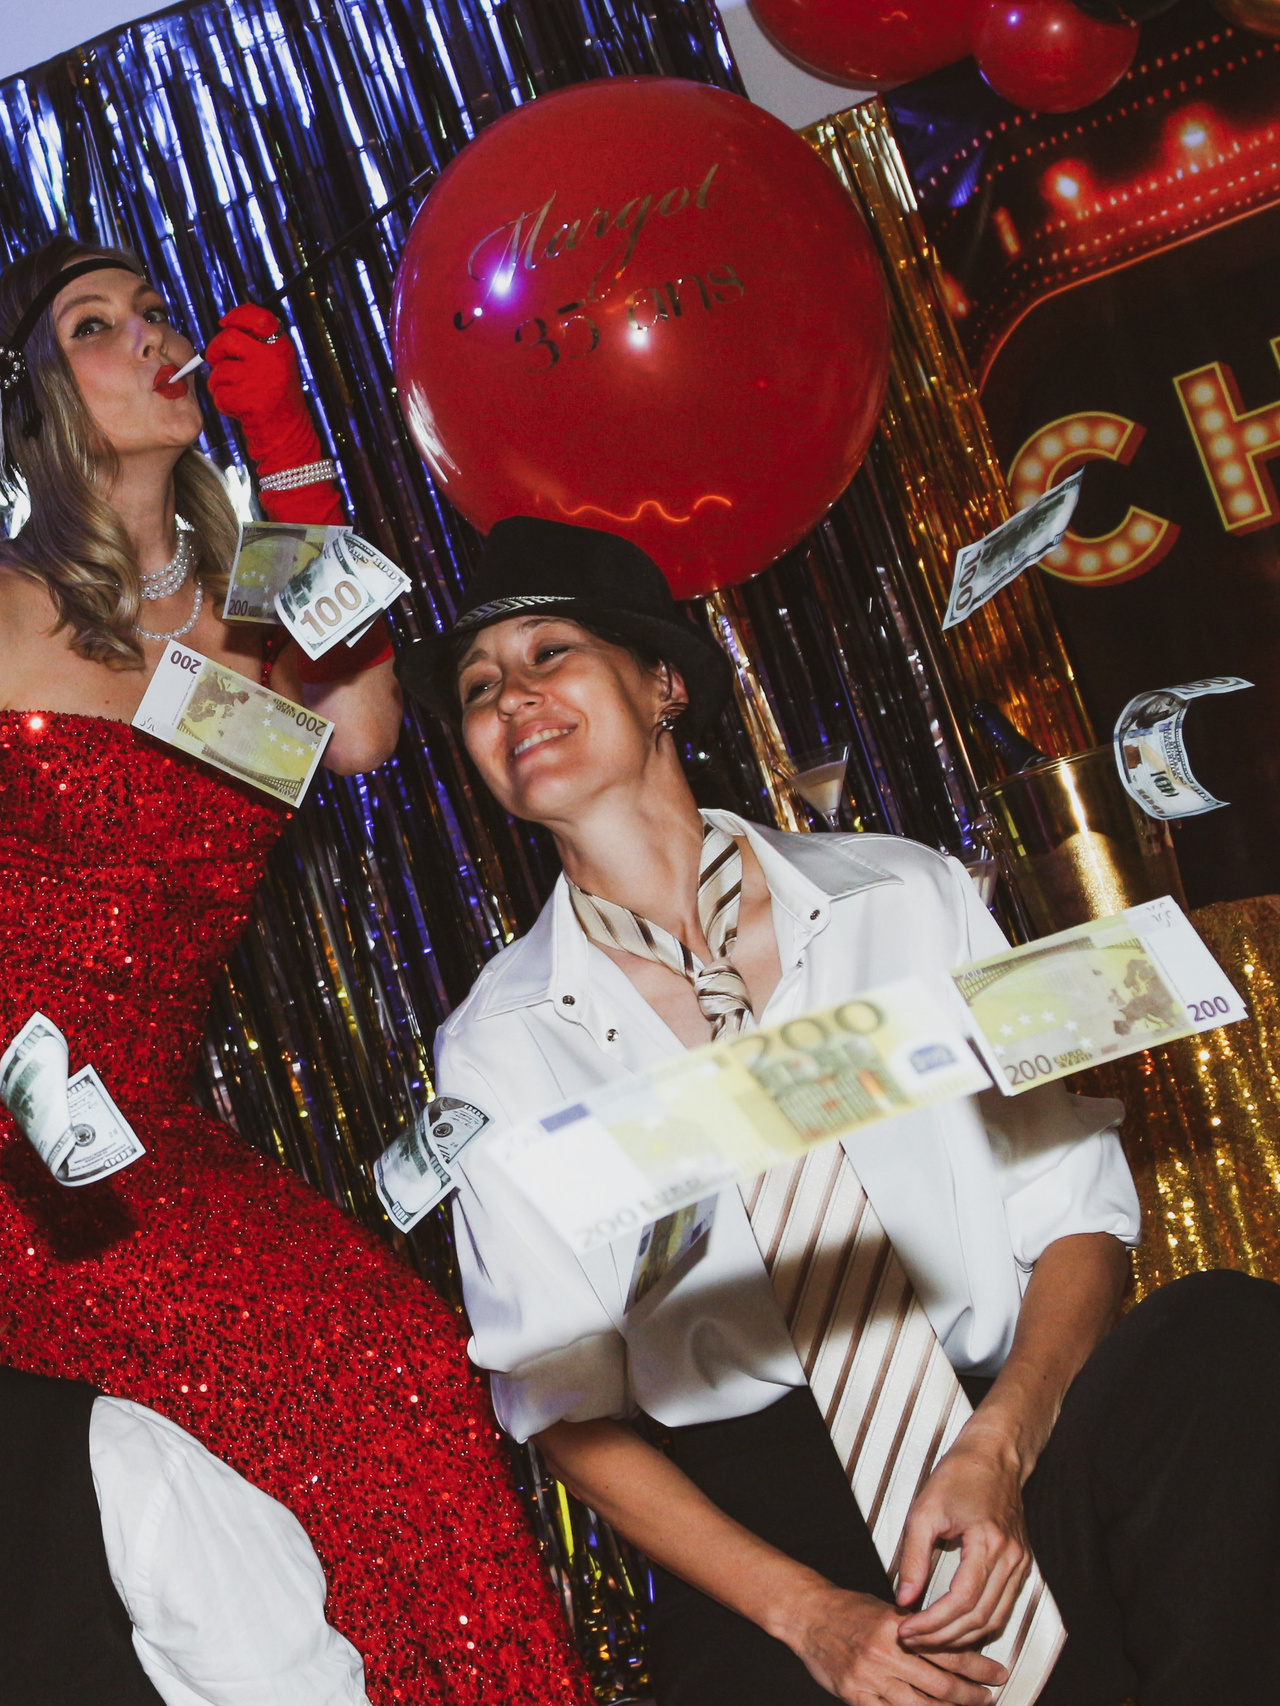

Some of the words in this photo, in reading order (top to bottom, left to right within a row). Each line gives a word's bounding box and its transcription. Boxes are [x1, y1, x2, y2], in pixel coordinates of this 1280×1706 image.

[453, 163, 719, 331] Margot
[514, 300, 600, 373] 35
[626, 263, 744, 331] ans
[955, 549, 982, 612] 100
[228, 600, 248, 616] 200
[300, 579, 362, 638] 100
[170, 649, 203, 676] 200
[295, 710, 328, 738] 200
[1187, 995, 1231, 1022] 200
[1004, 1054, 1053, 1086] 200
